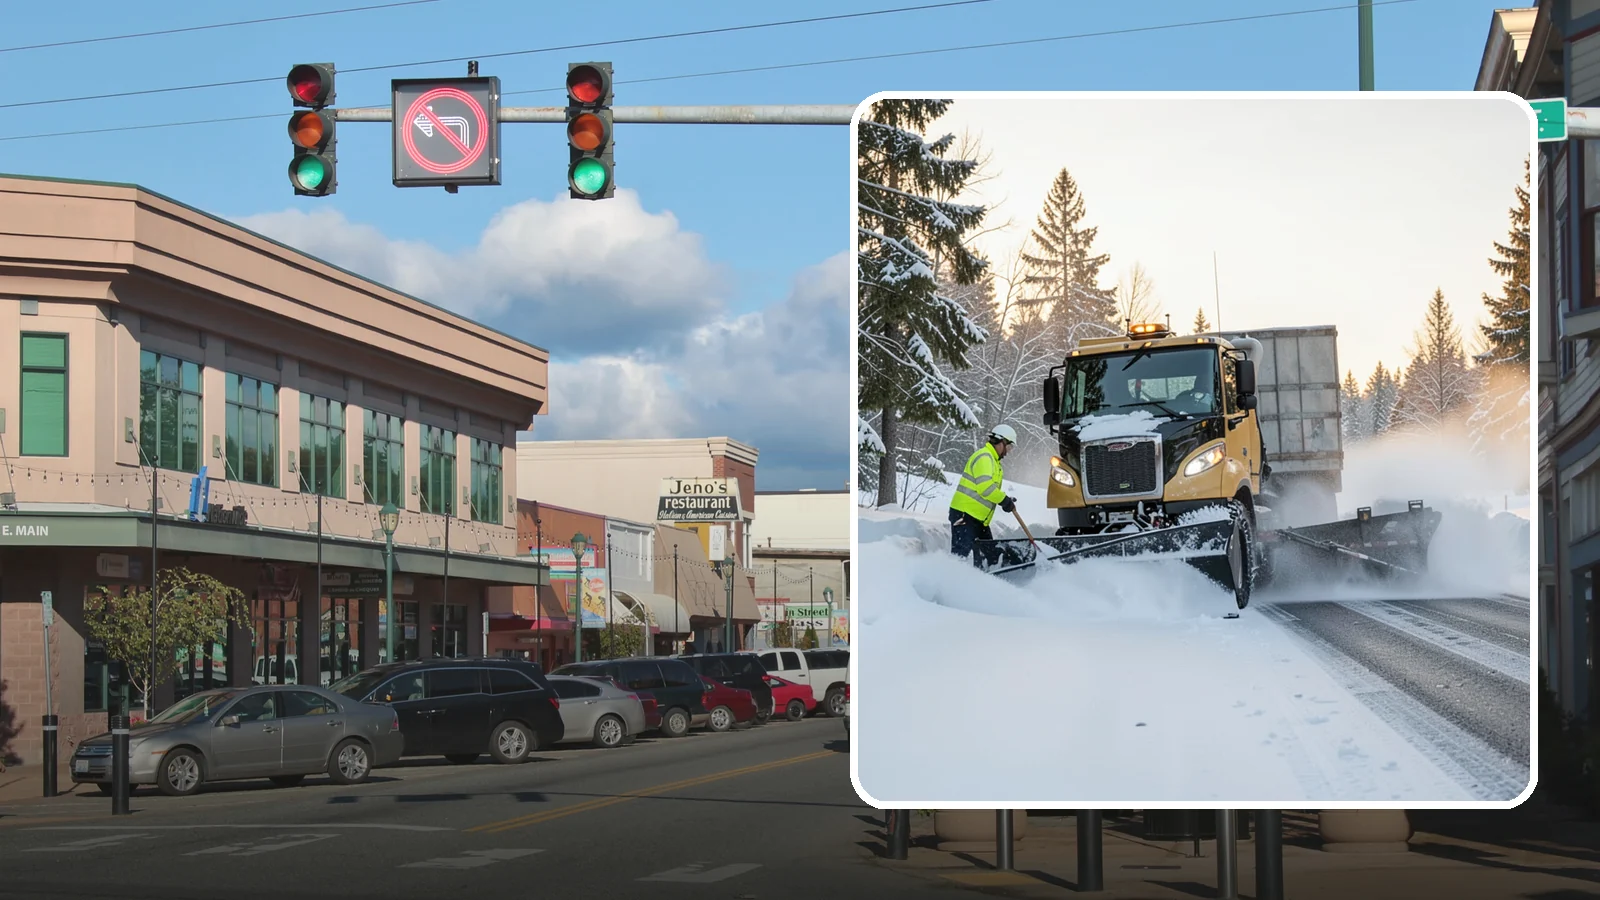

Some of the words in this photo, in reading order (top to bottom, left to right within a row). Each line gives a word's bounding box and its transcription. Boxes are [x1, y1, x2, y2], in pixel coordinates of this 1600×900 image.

[669, 480, 727, 494] Jeno's
[665, 497, 730, 508] restaurant
[658, 510, 682, 520] Italian
[686, 510, 715, 519] American
[715, 510, 738, 519] Cuisine
[2, 525, 13, 536] E.
[15, 525, 49, 536] MAIN
[797, 607, 828, 617] Street
[790, 619, 824, 627] lass
